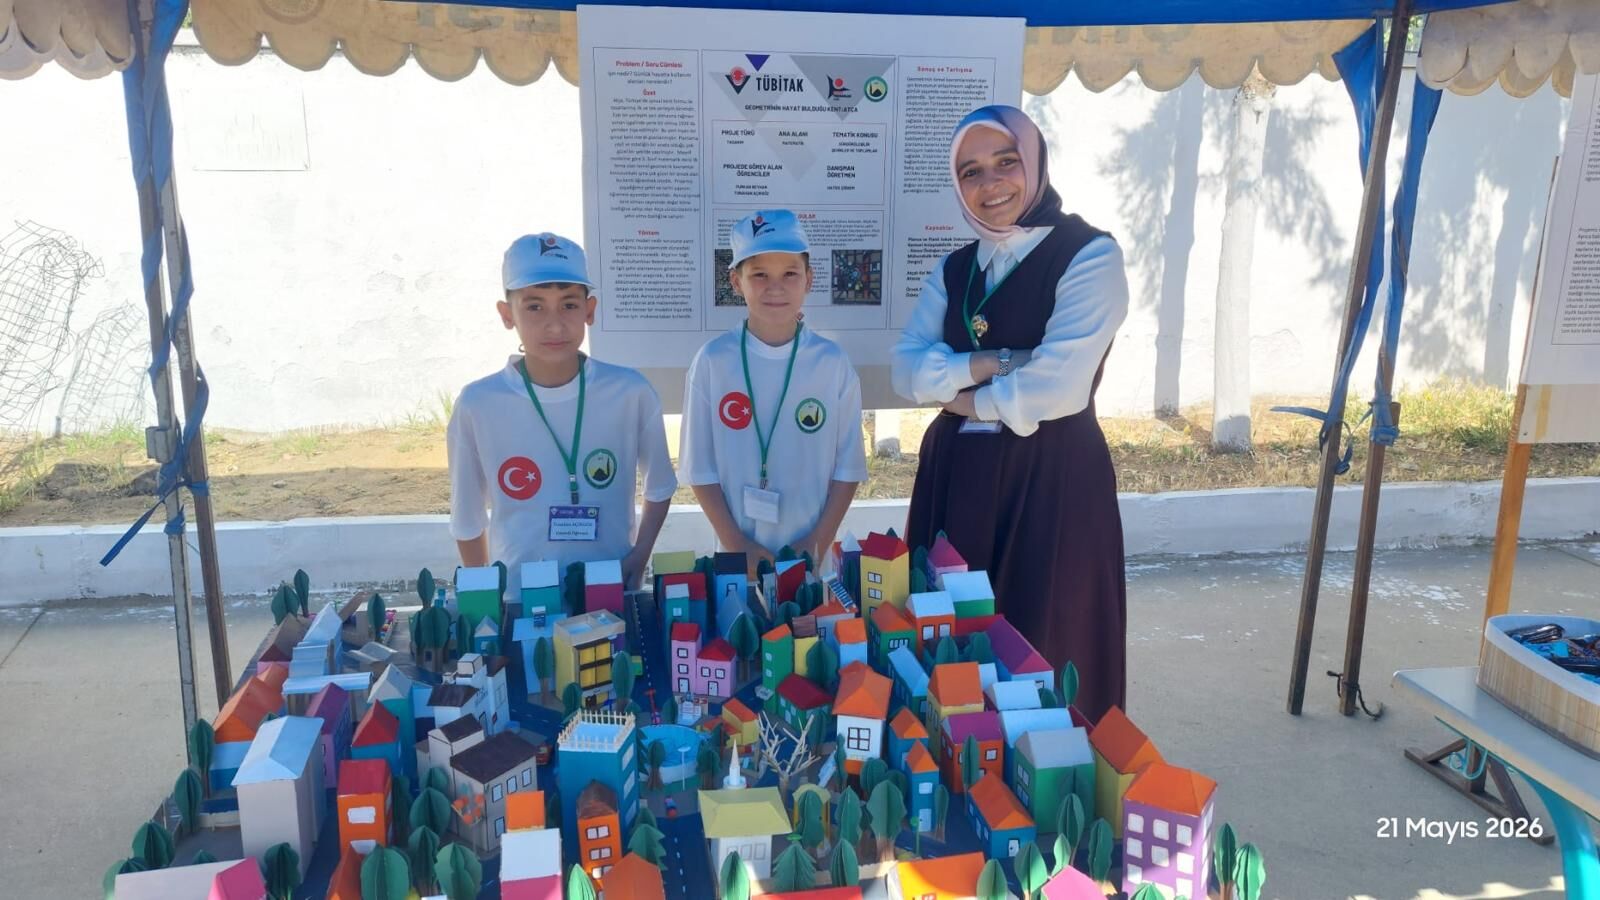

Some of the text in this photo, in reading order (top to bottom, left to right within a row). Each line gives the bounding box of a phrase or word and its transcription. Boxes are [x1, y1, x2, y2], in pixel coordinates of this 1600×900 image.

[615, 60, 641, 68] Problem
[917, 66, 936, 74] Sonuç
[756, 75, 804, 93] TÜBİTAK
[745, 104, 781, 112] GEOMETRİNİN
[801, 105, 827, 113] BULDUĞU
[740, 129, 755, 137] TÜRÜ
[748, 163, 767, 171] GÖREV
